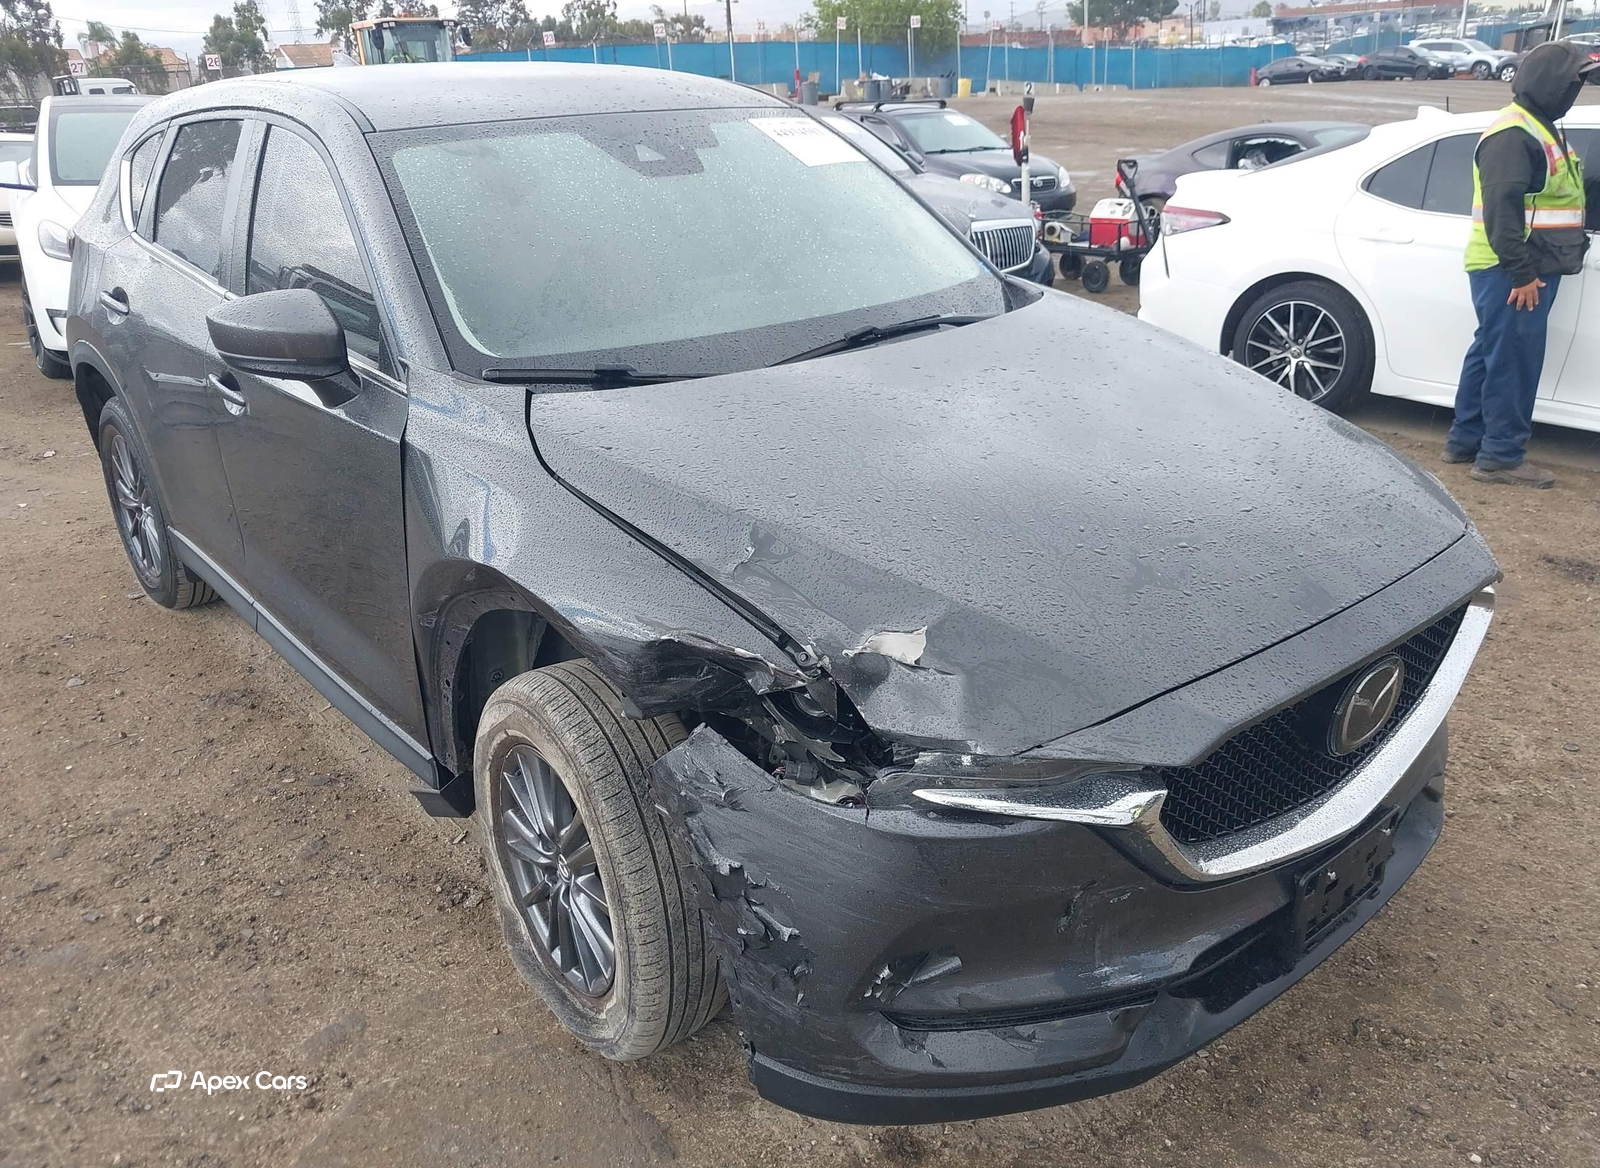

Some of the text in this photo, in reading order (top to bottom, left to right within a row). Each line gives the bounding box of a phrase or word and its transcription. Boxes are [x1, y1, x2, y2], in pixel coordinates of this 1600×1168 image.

[655, 26, 665, 34] 22
[758, 22, 766, 30] 21
[544, 34, 554, 43] 23
[207, 57, 219, 67] 26
[71, 63, 84, 73] 27
[1025, 82, 1032, 94] 2
